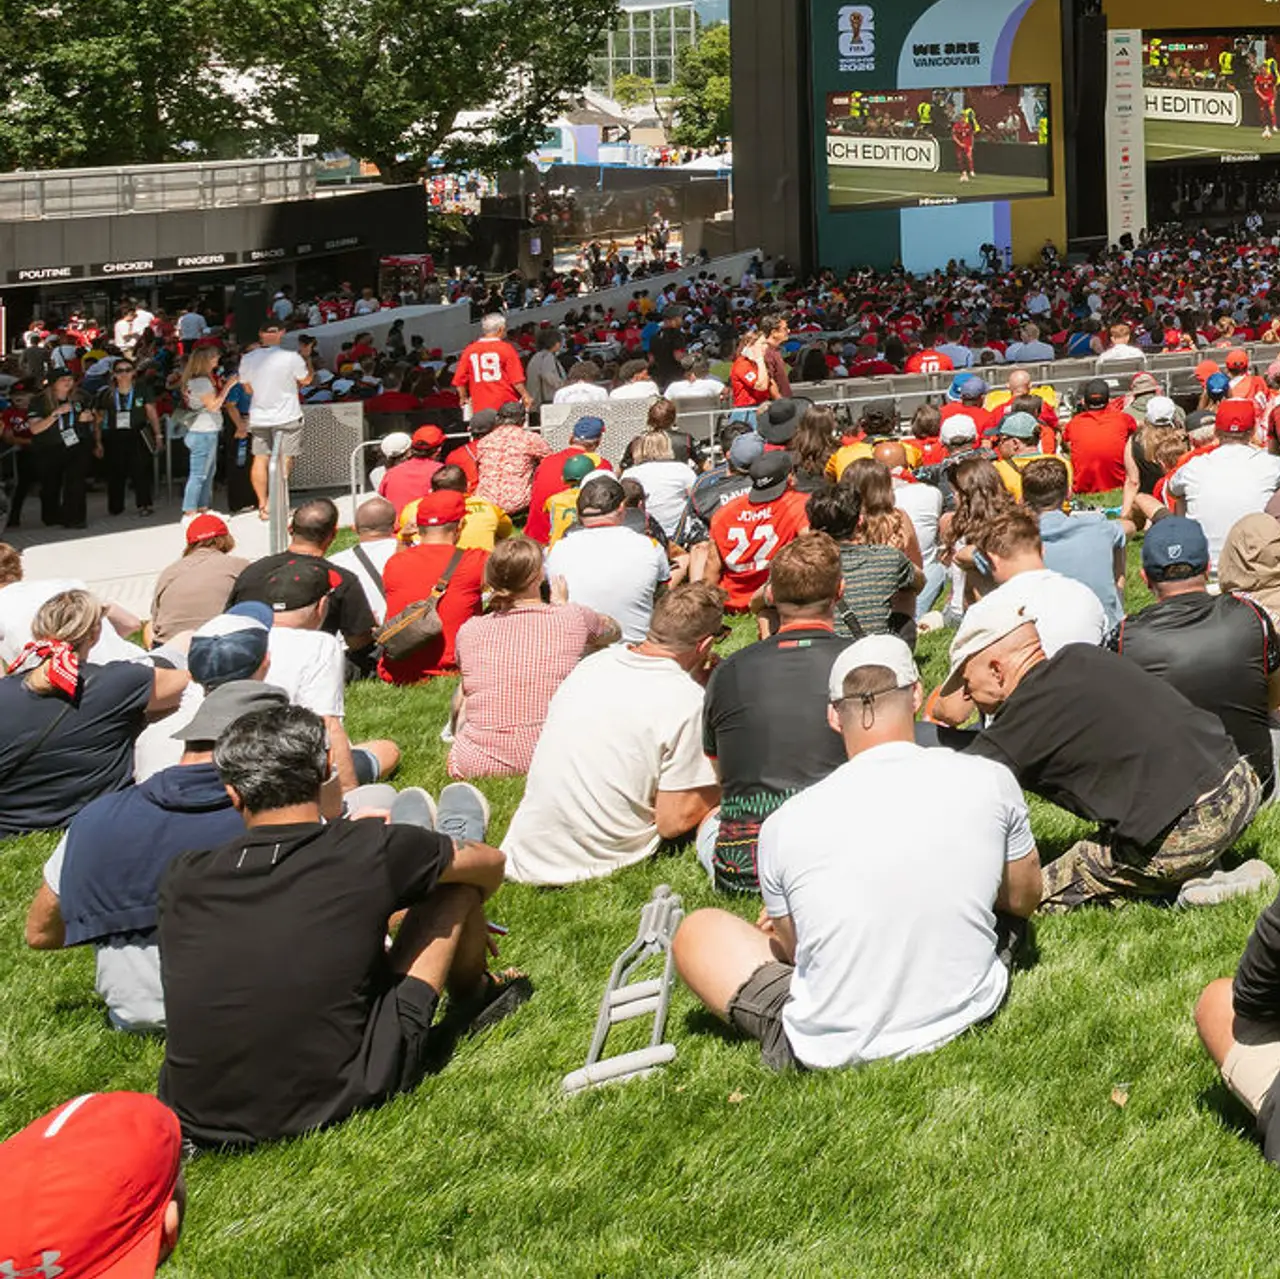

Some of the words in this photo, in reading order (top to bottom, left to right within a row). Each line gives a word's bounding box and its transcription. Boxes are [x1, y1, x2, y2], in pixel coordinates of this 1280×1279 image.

[912, 44, 941, 56] WE
[944, 42, 980, 55] ARE
[913, 56, 980, 67] VANCOUVER
[1162, 96, 1234, 116] EDITION
[862, 144, 932, 162] EDITION
[102, 260, 154, 273] CHICKEN
[177, 254, 226, 267] FINGERS
[18, 267, 71, 280] POUTINE
[469, 351, 502, 383] 19
[725, 524, 780, 573] 22
